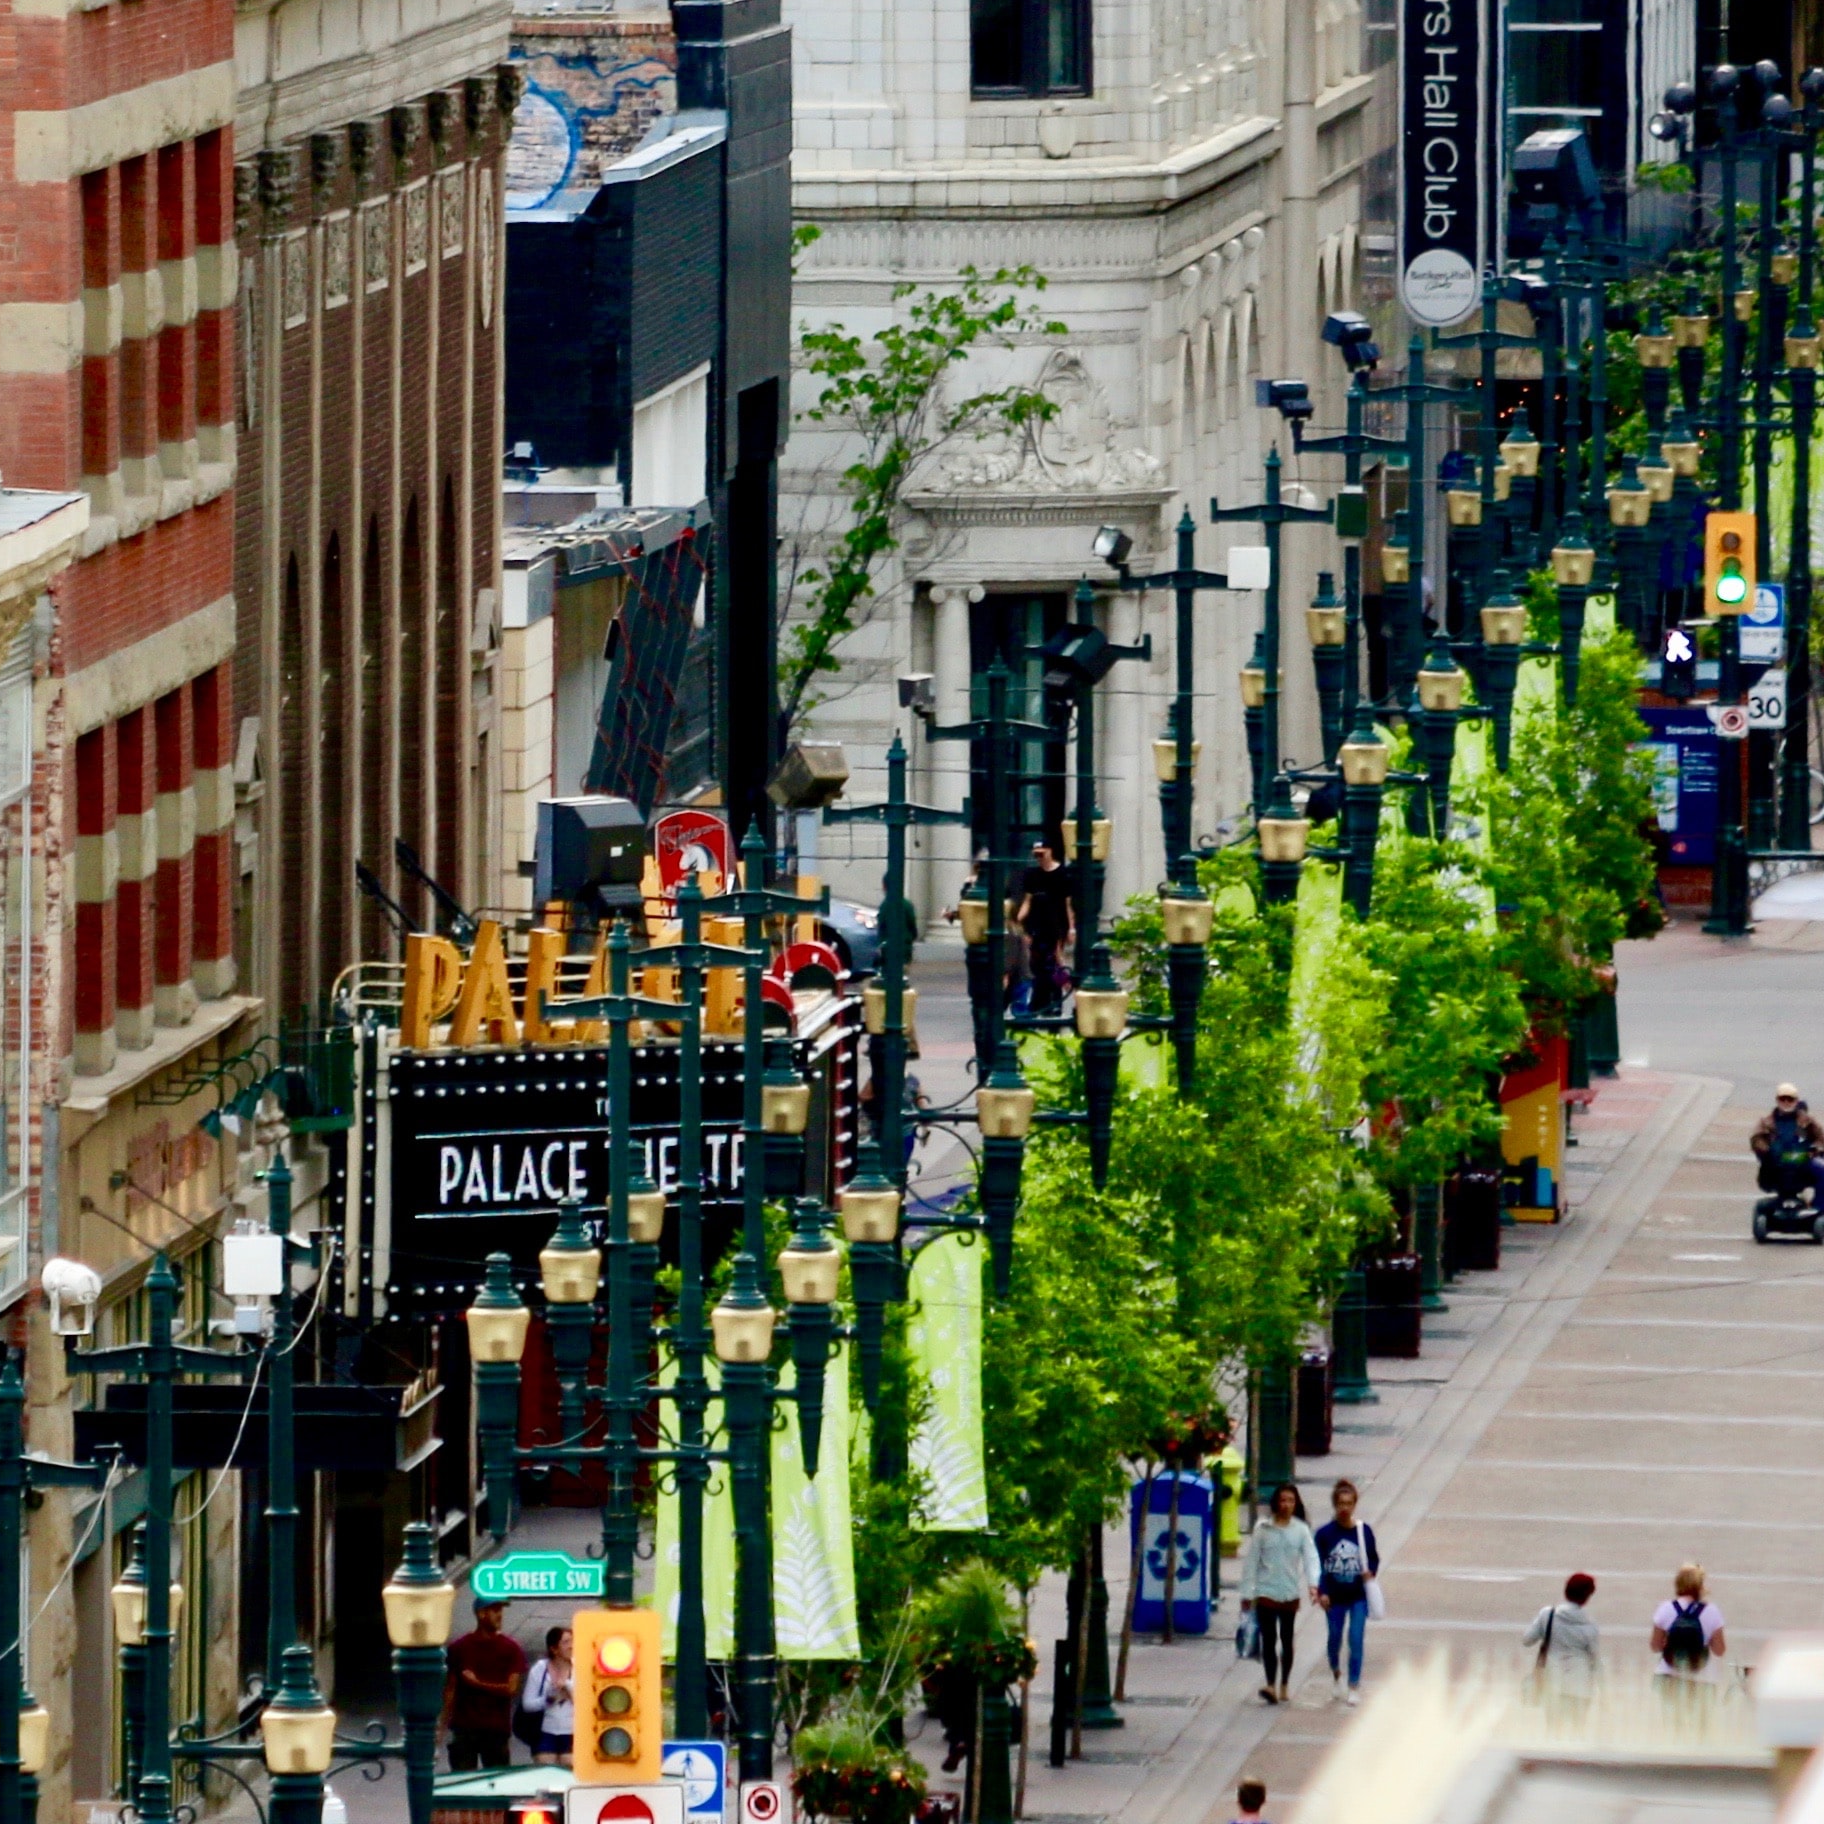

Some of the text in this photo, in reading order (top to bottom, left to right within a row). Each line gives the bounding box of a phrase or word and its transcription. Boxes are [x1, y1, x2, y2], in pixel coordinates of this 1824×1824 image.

[1423, 47, 1459, 126] Hall
[1423, 137, 1459, 238] Club
[1749, 696, 1782, 719] 30
[439, 1140, 588, 1205] PALACE
[487, 1570, 592, 1591] 1 STREET SW
